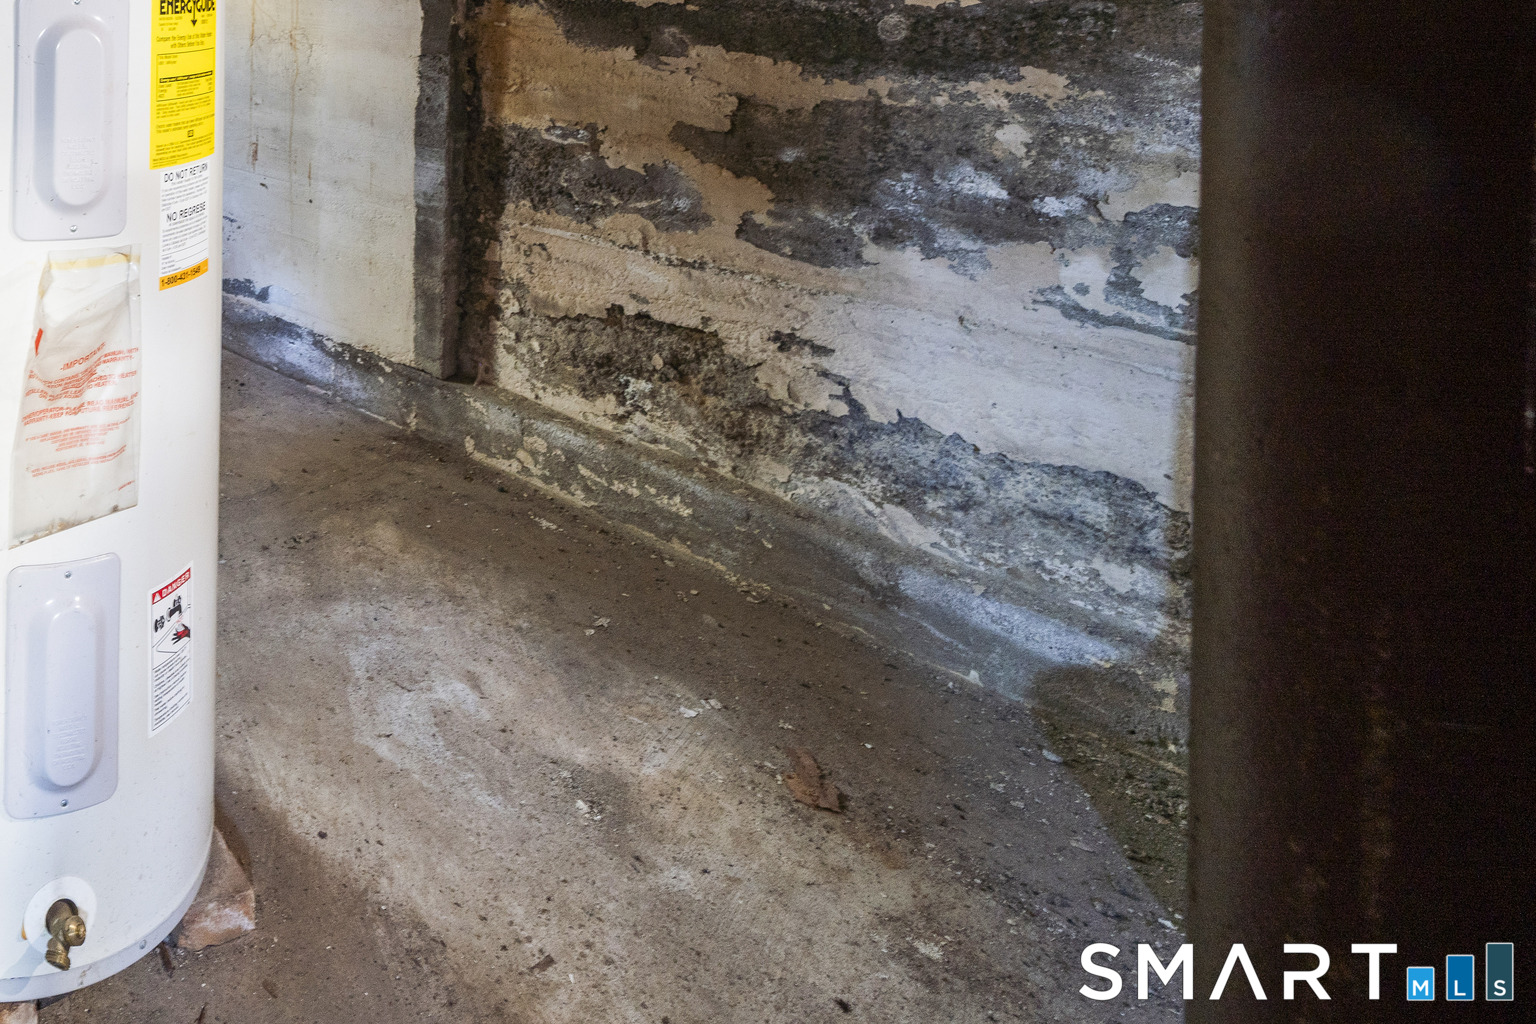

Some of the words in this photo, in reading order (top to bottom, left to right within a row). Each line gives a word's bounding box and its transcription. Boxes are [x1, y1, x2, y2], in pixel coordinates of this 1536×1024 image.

[164, 172, 174, 183] DO
[176, 168, 188, 180] NOT
[167, 211, 177, 223] NO
[179, 201, 206, 219] REGRESE
[161, 571, 190, 598] DANGER
